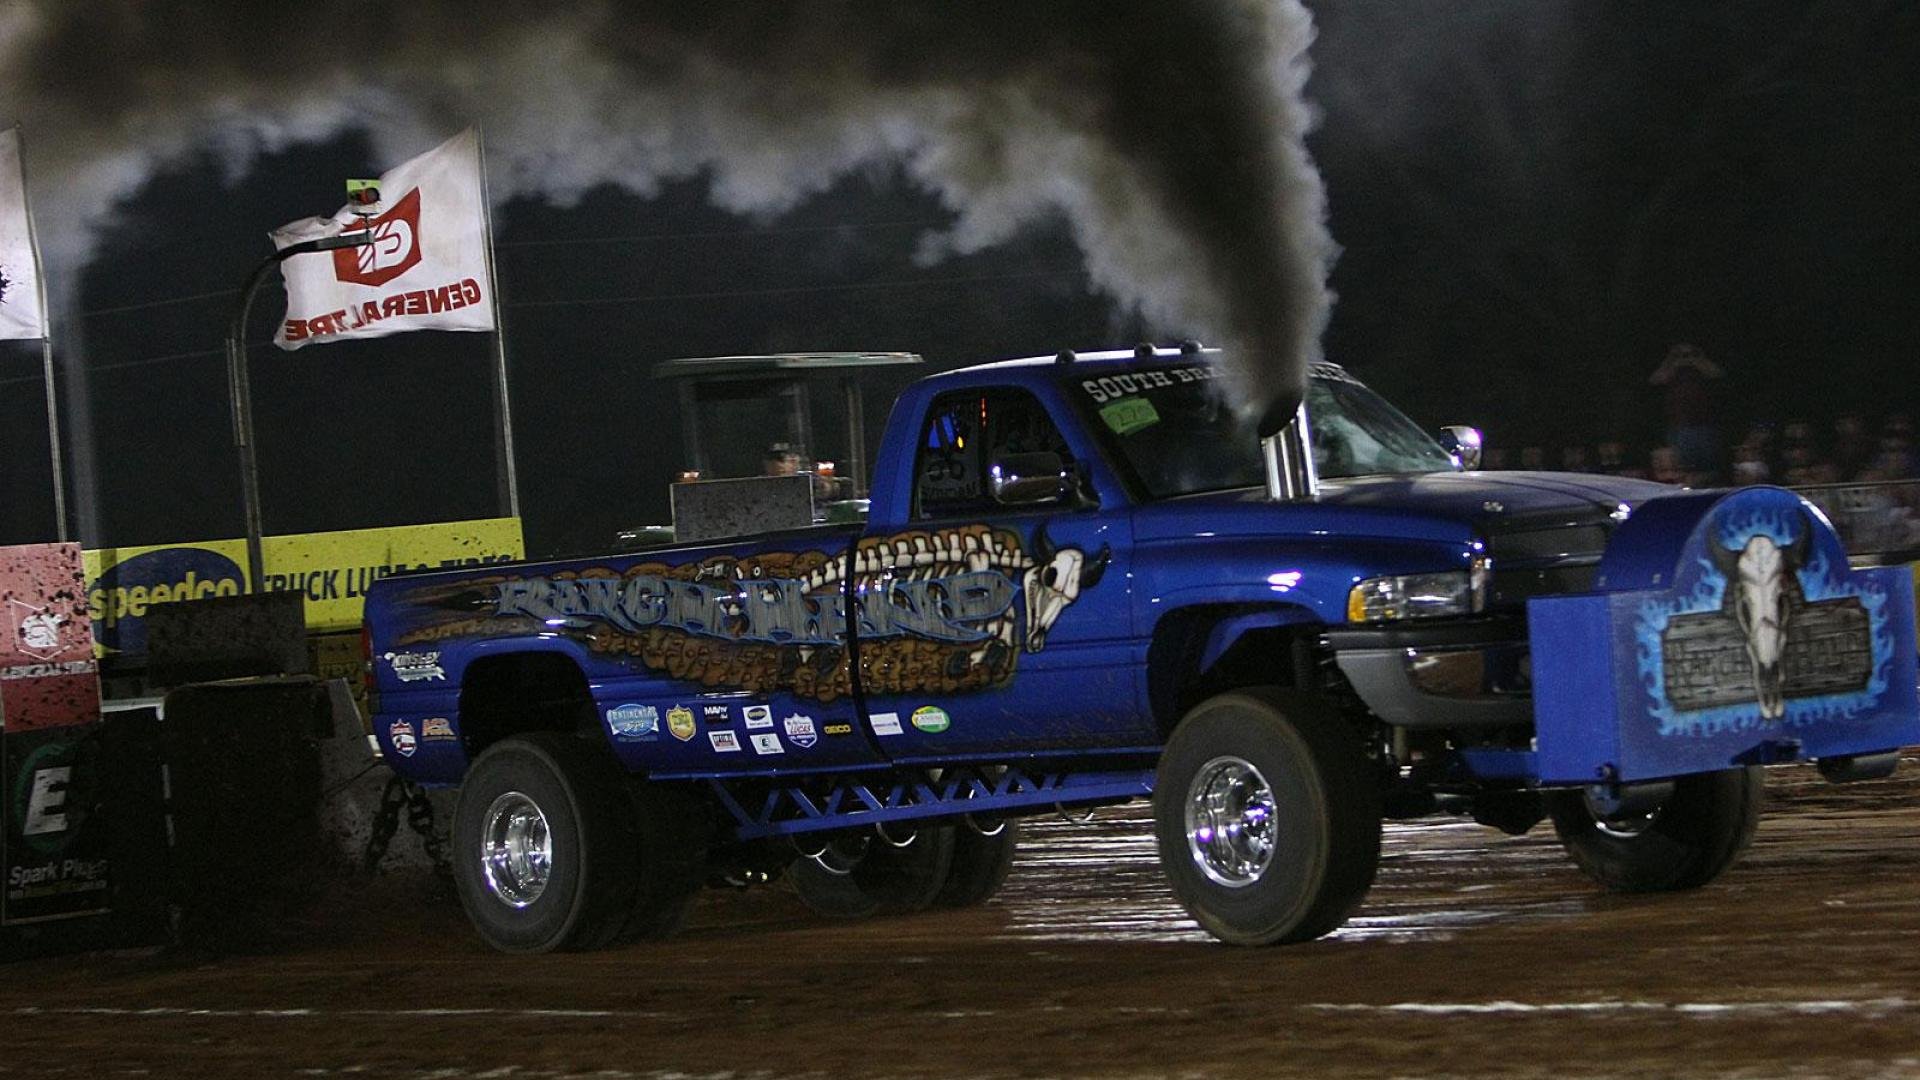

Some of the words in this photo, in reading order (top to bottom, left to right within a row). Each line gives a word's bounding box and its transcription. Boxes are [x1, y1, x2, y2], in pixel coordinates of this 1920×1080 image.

[1082, 369, 1174, 403] SOUTH
[89, 571, 238, 629] speedco
[23, 766, 72, 835] E
[9, 861, 58, 888] Spark
